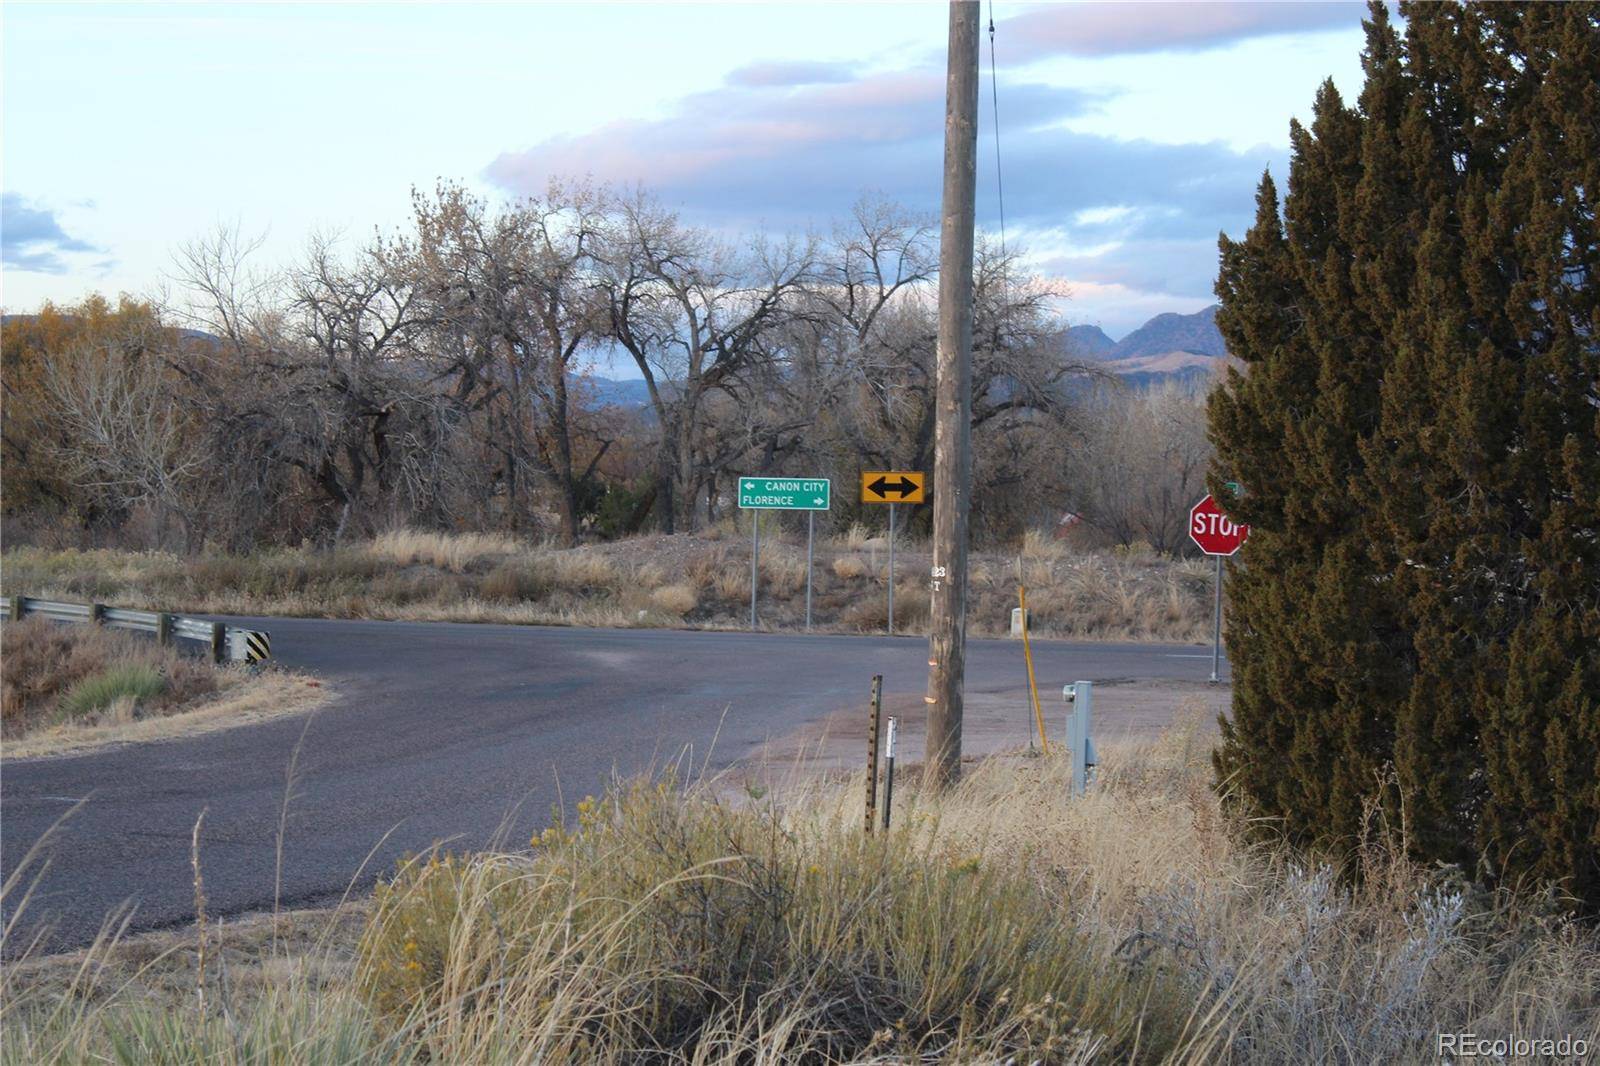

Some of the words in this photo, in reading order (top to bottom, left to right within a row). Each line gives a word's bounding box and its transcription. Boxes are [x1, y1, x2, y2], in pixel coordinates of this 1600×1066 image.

[765, 482, 800, 491] CANON
[803, 482, 825, 492] CITY
[743, 495, 794, 505] FLORENCE
